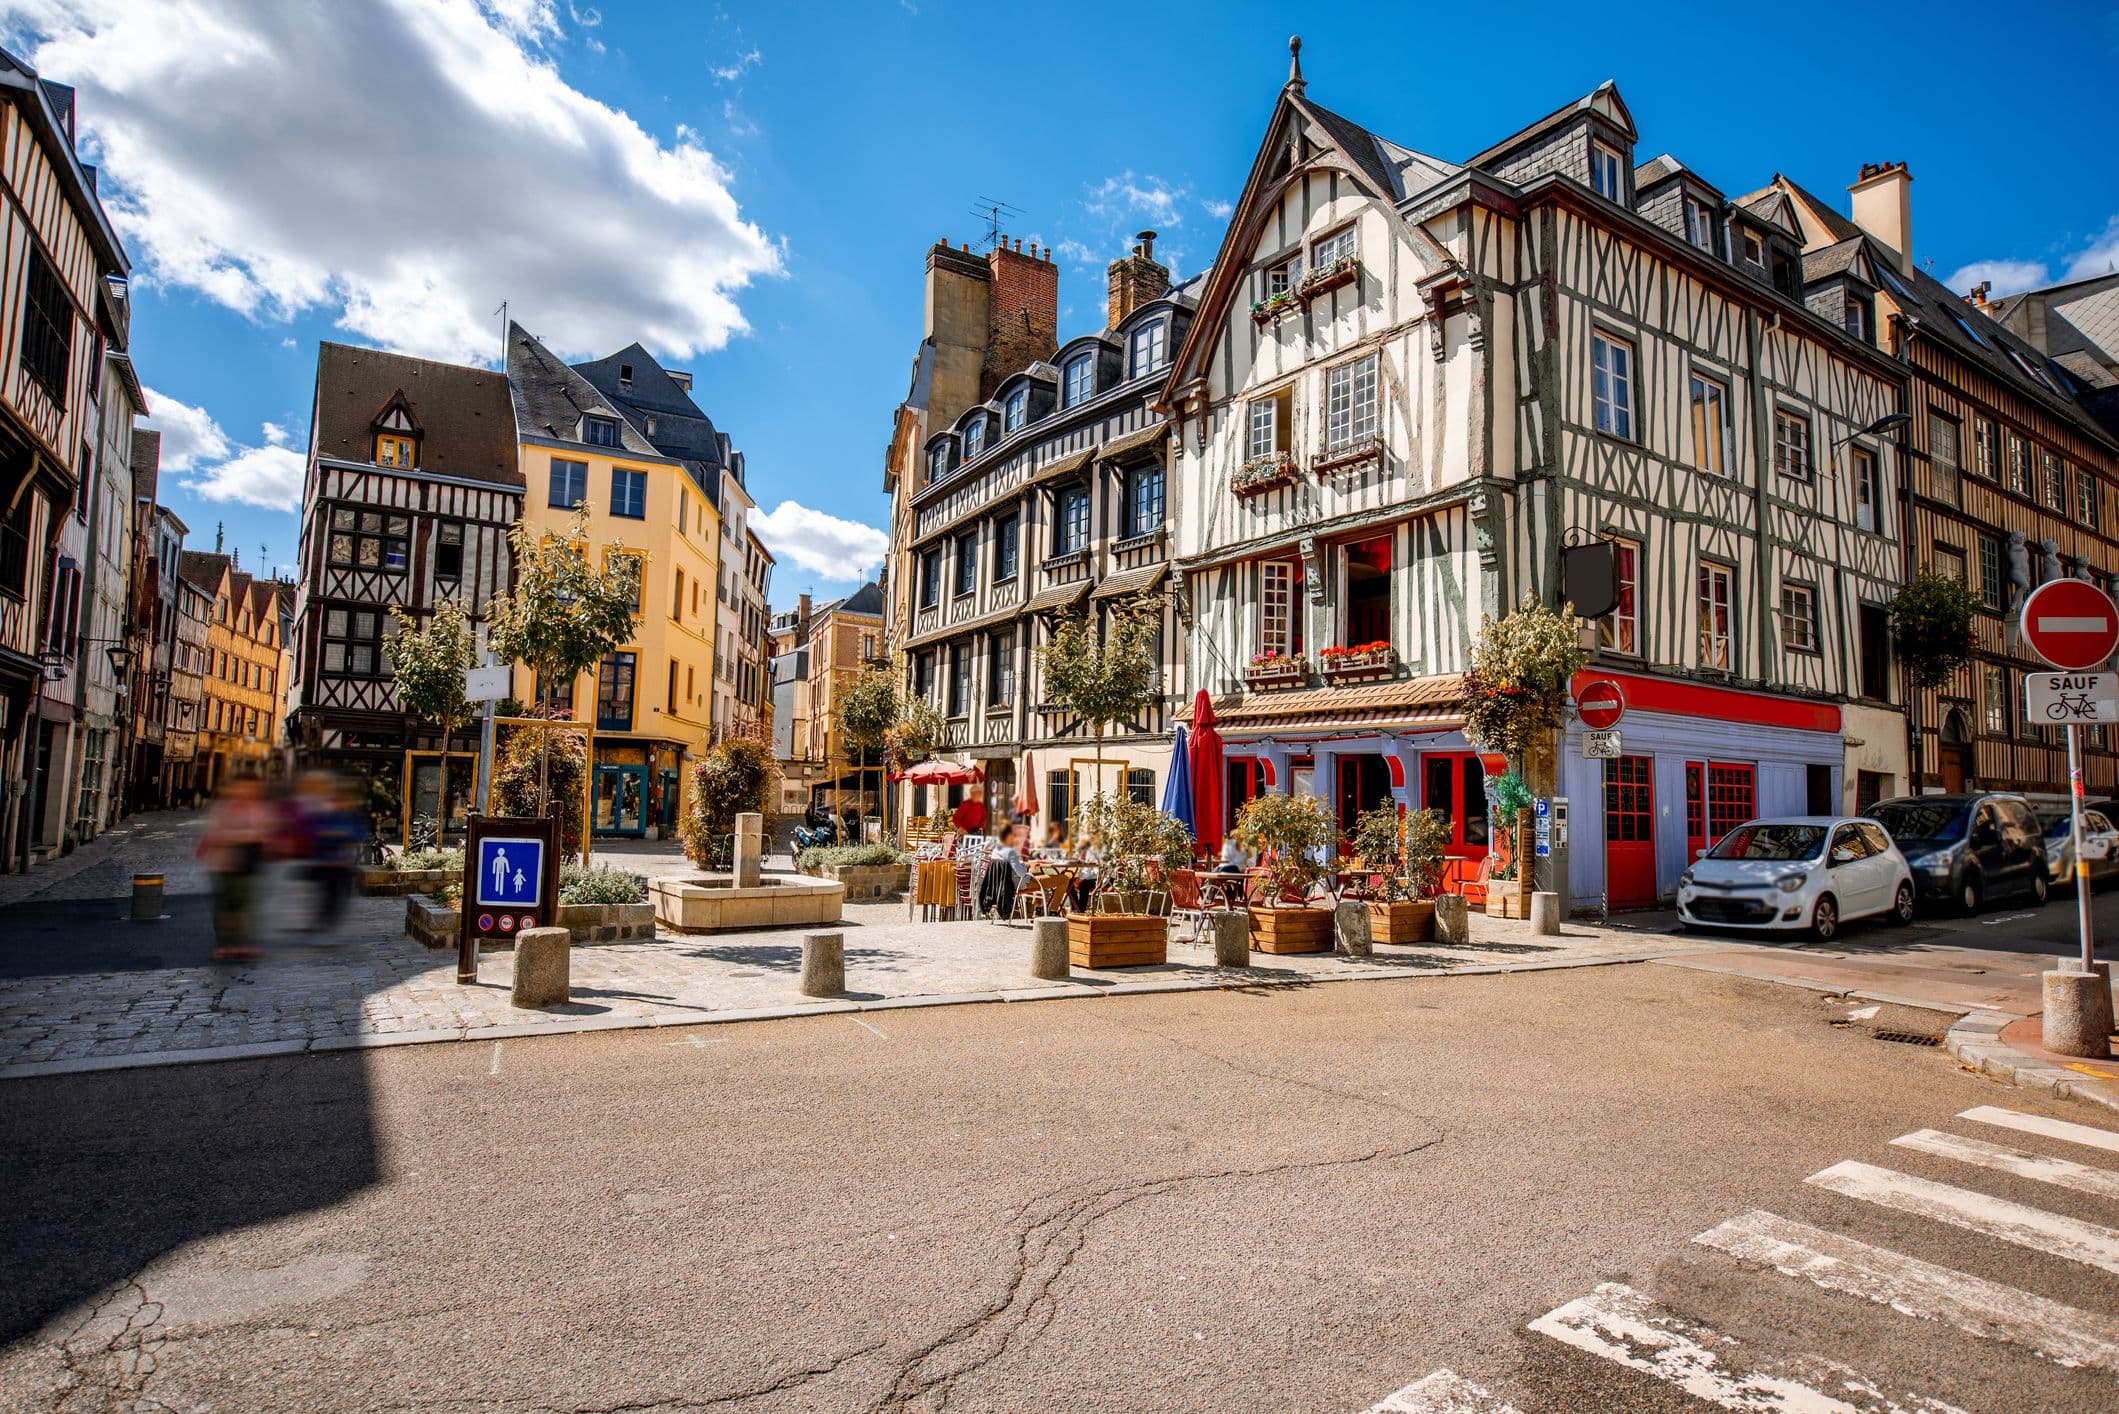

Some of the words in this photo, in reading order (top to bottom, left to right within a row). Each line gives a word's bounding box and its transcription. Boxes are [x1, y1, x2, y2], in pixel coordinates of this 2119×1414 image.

[2049, 676, 2099, 690] SAUF
[1590, 732, 1612, 741] SAUF
[1538, 803, 1546, 815] P
